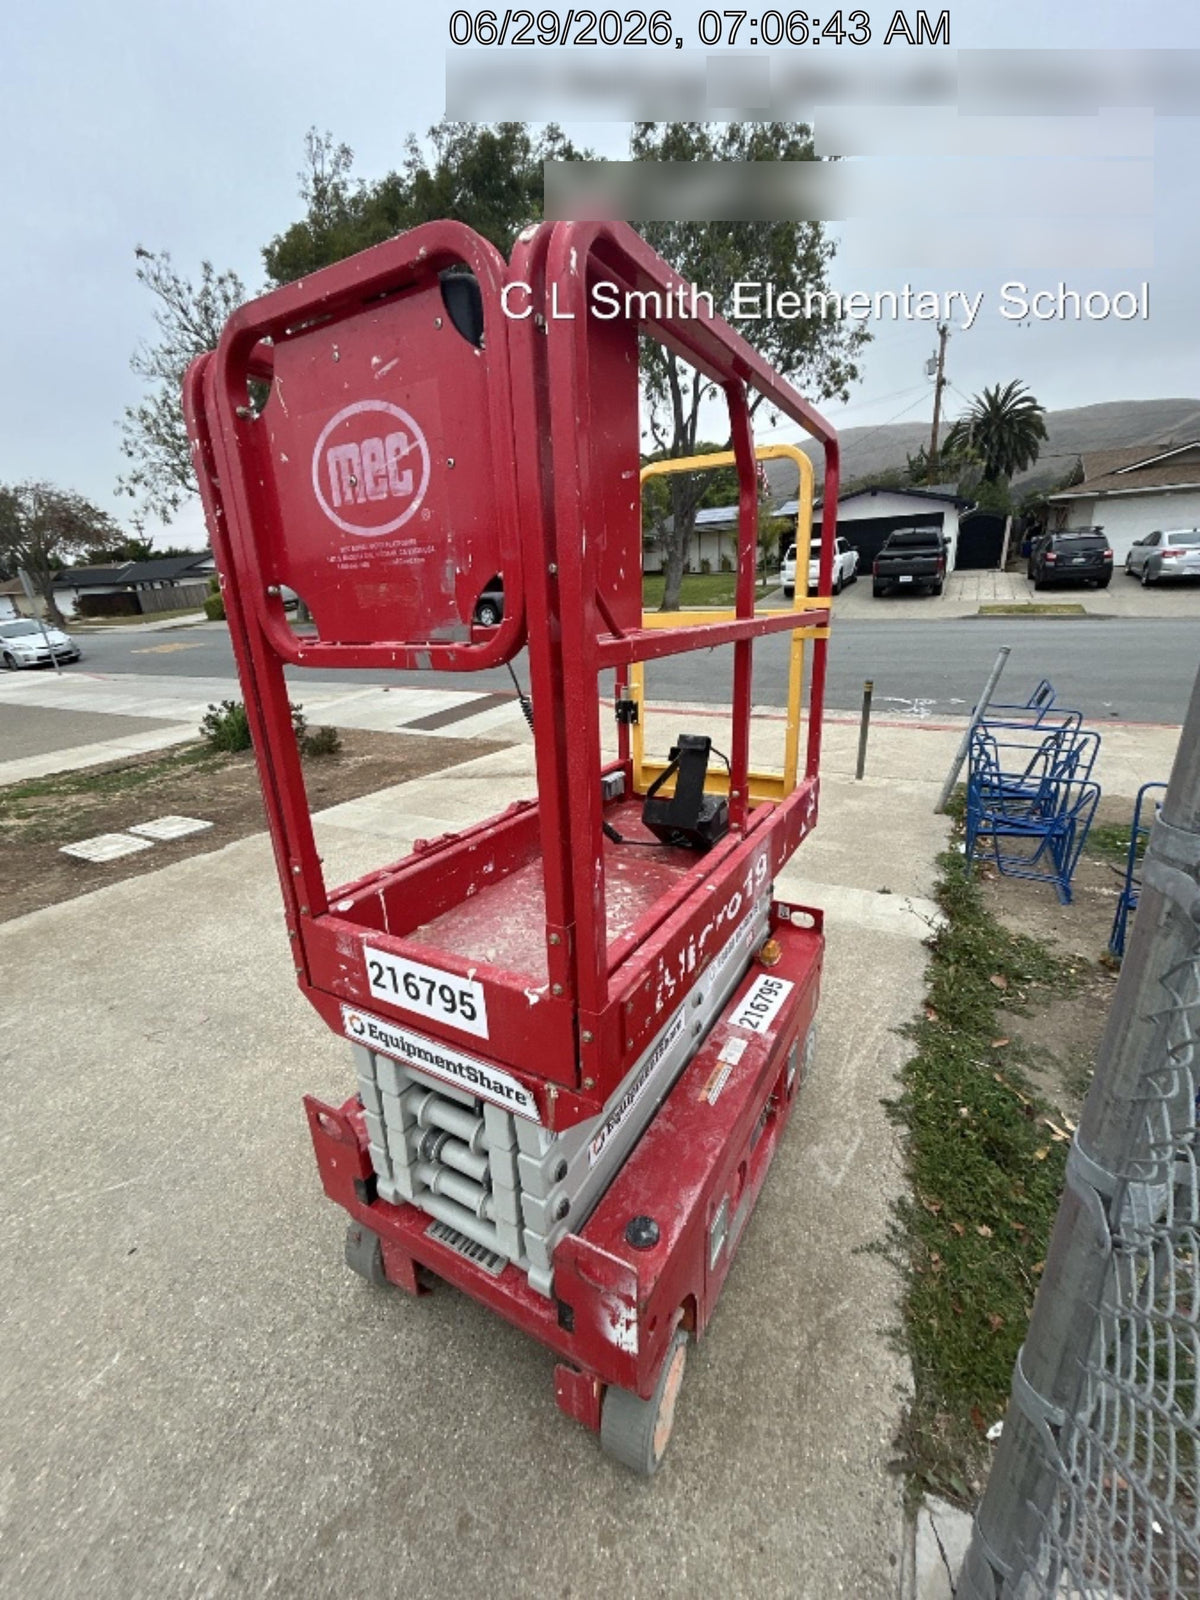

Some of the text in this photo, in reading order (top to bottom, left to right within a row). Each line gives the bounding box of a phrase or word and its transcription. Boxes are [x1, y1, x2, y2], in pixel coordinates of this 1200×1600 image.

[369, 960, 478, 1022] 216795
[738, 978, 784, 1030] 216795
[367, 1021, 528, 1108] EquipmentShare
